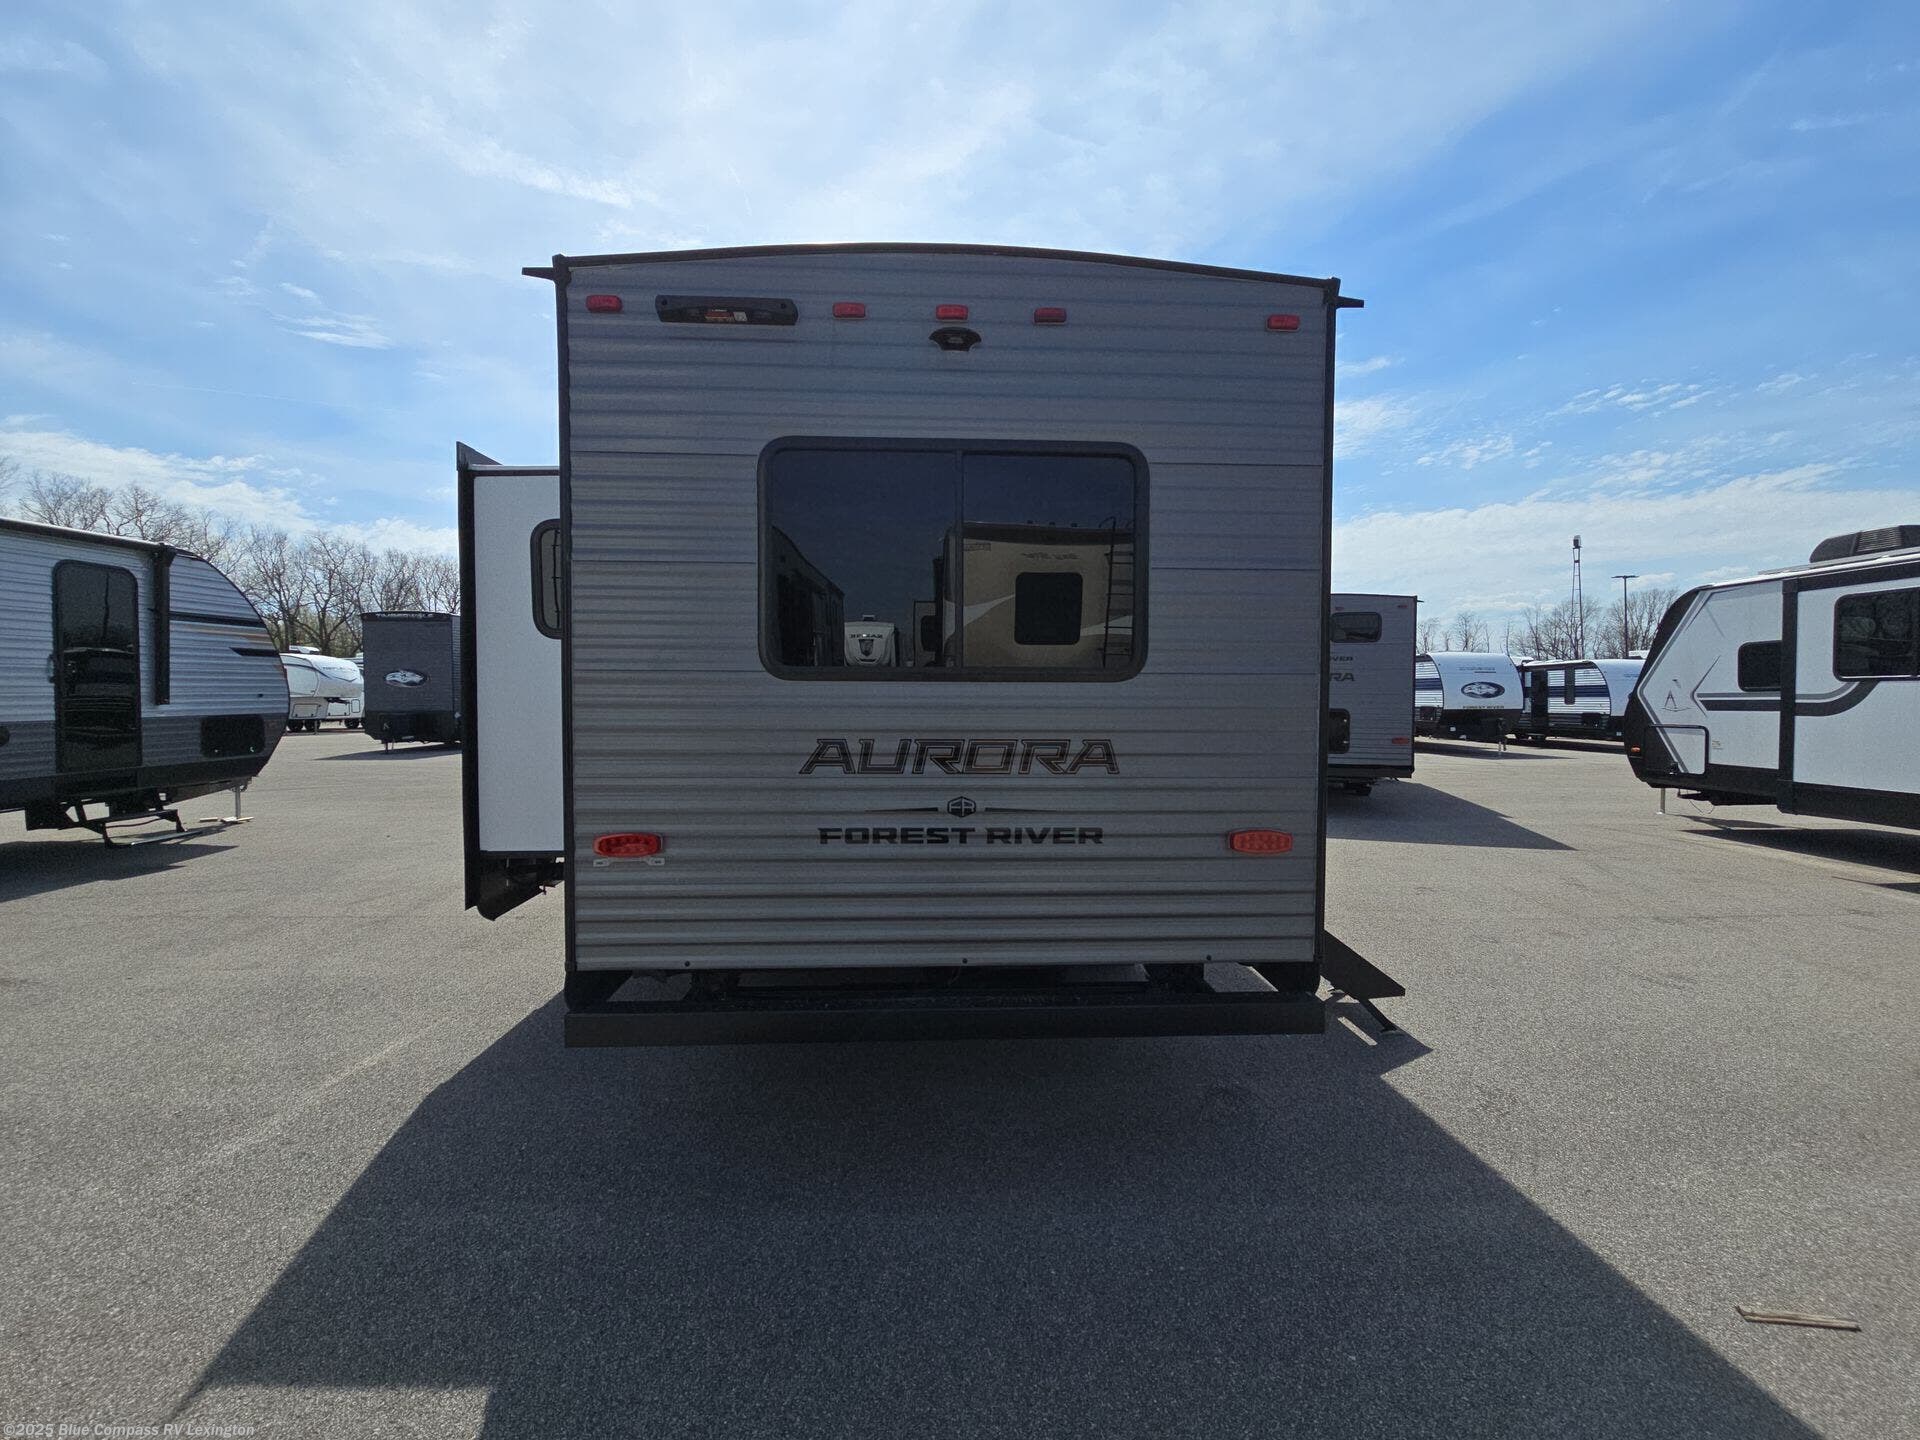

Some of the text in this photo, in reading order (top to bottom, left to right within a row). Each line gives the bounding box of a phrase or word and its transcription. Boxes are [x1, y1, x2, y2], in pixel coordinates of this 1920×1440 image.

[798, 738, 1120, 774] AURORA
[817, 827, 1104, 844] FOREST RIVER
